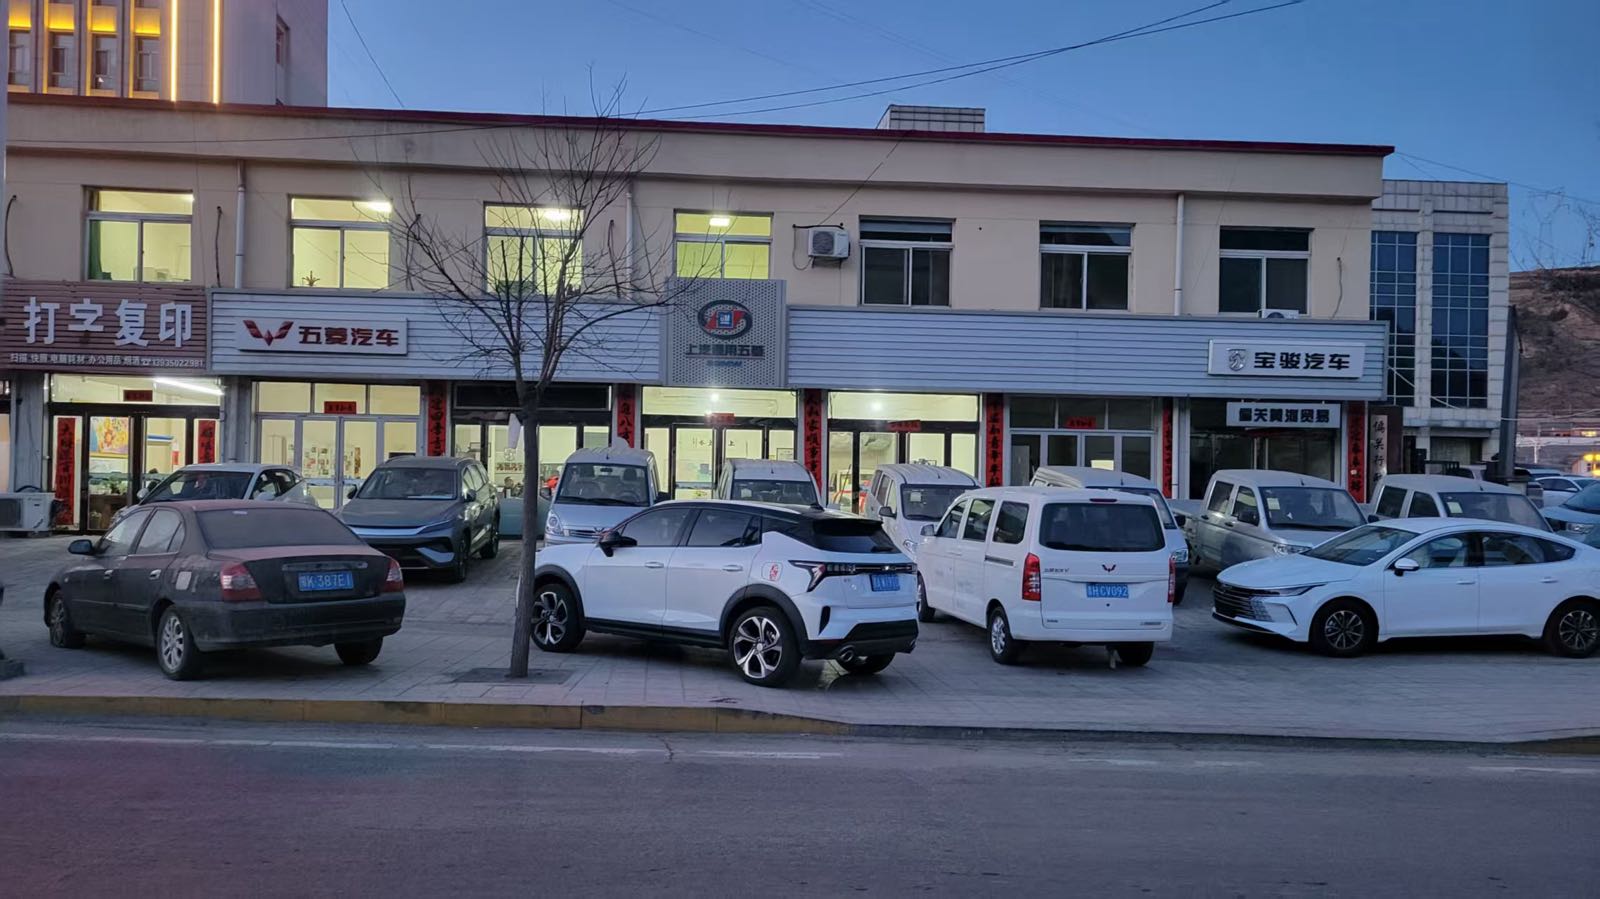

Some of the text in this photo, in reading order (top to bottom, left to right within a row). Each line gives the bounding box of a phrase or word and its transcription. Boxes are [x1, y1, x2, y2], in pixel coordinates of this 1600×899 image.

[23, 296, 192, 348] 打字复印
[298, 326, 399, 347] 五菱汽车
[1253, 352, 1351, 370] 宝骏汽车
